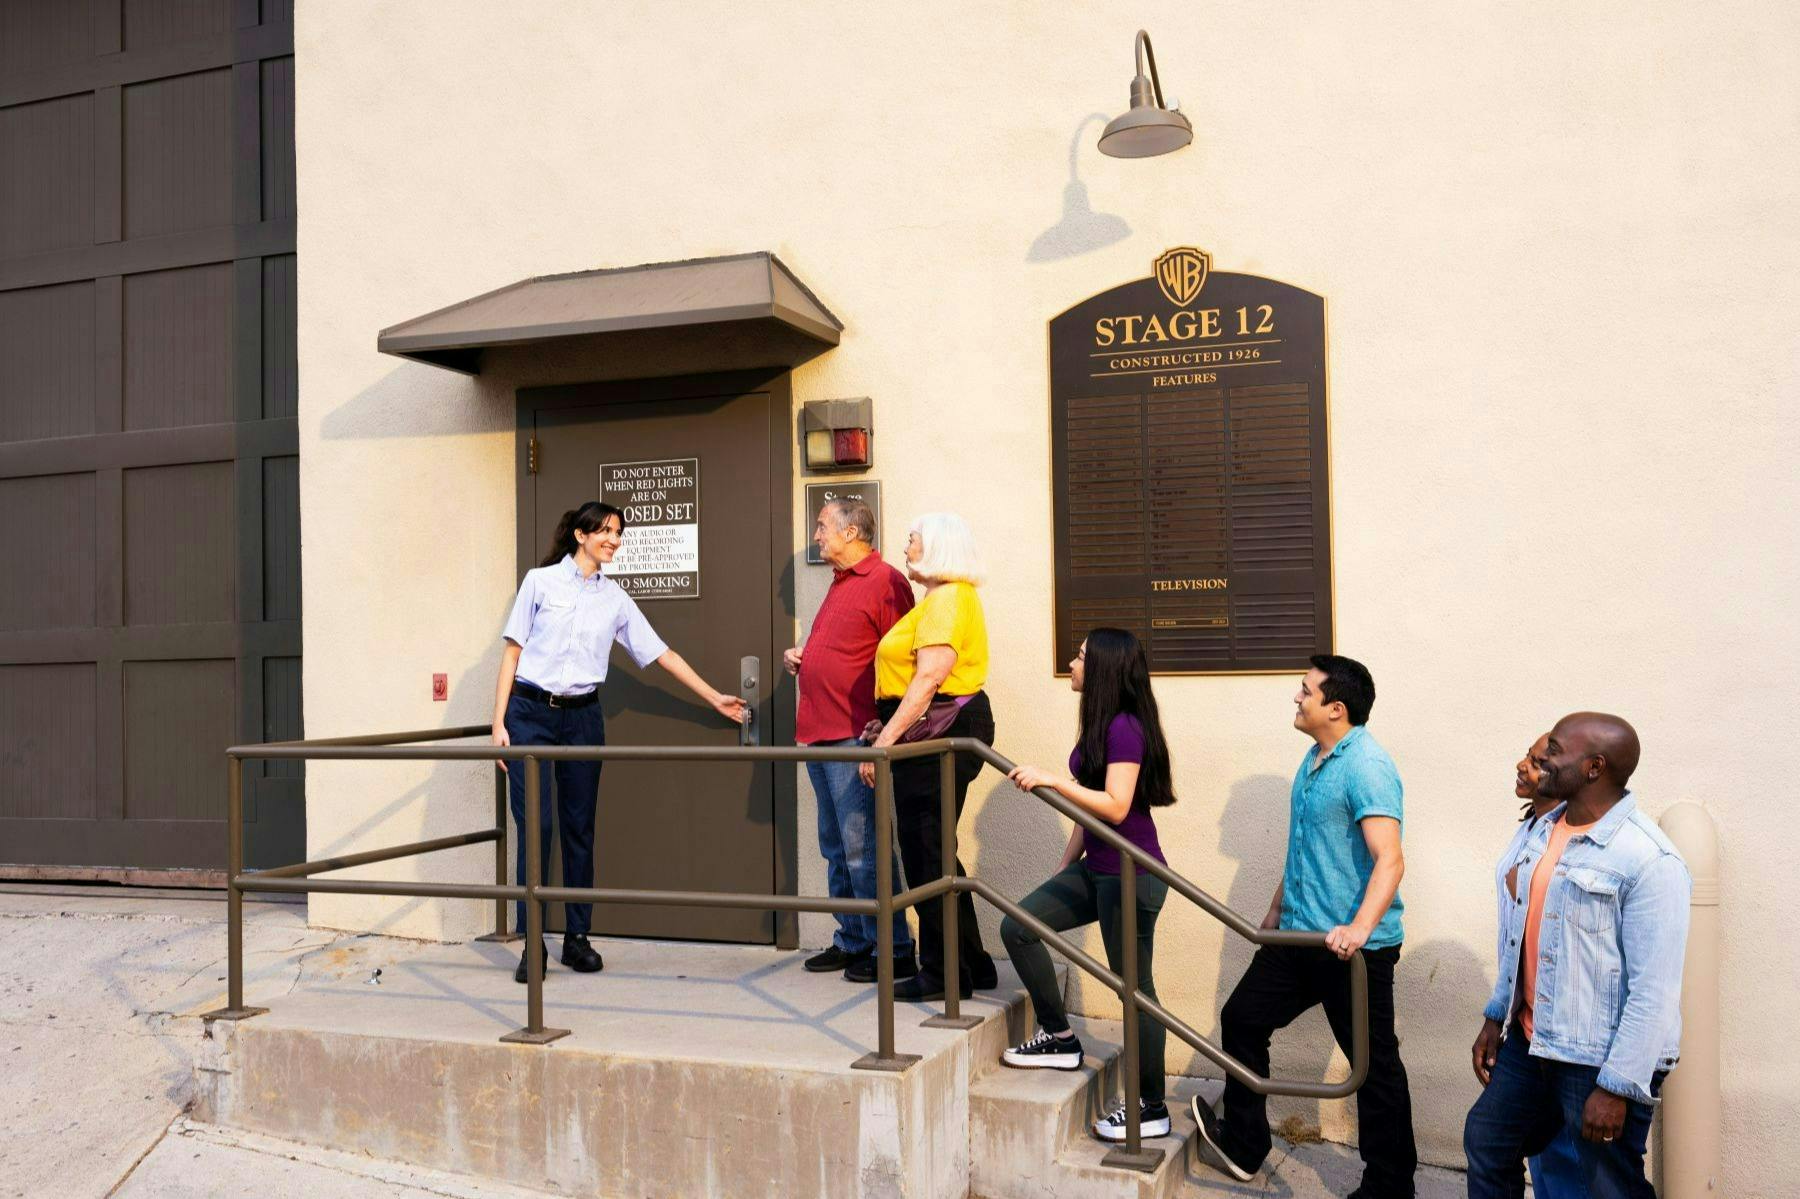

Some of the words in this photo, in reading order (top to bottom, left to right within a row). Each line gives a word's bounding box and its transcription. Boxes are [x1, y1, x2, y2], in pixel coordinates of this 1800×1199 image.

[1161, 254, 1202, 301] WB
[1095, 308, 1222, 347] STAGE
[1235, 304, 1274, 336] 12
[1110, 351, 1222, 370] CONSTRUCTED
[1228, 348, 1261, 361] 1926
[1152, 372, 1217, 387] FEATURES
[613, 469, 627, 479] DO
[629, 467, 650, 478] NOT
[652, 465, 684, 477] ENTER
[604, 480, 634, 491] WHEN
[636, 479, 655, 490] RED
[657, 477, 693, 488] LIGHTS
[630, 491, 650, 502] ARE
[651, 490, 667, 500] ON
[623, 504, 662, 523] OSED
[666, 502, 693, 520] SET
[623, 530, 638, 538] ANY
[640, 529, 664, 537] AUDIO
[665, 528, 676, 536] OR
[639, 537, 684, 545] RECORDING
[626, 546, 671, 555] EQUIPMENT
[638, 552, 695, 562] PRE-APPROVED
[618, 563, 627, 571] BY
[629, 561, 680, 571] PRODUCTION
[633, 576, 690, 588] SMOKING
[1151, 578, 1228, 591] TELEVISION
